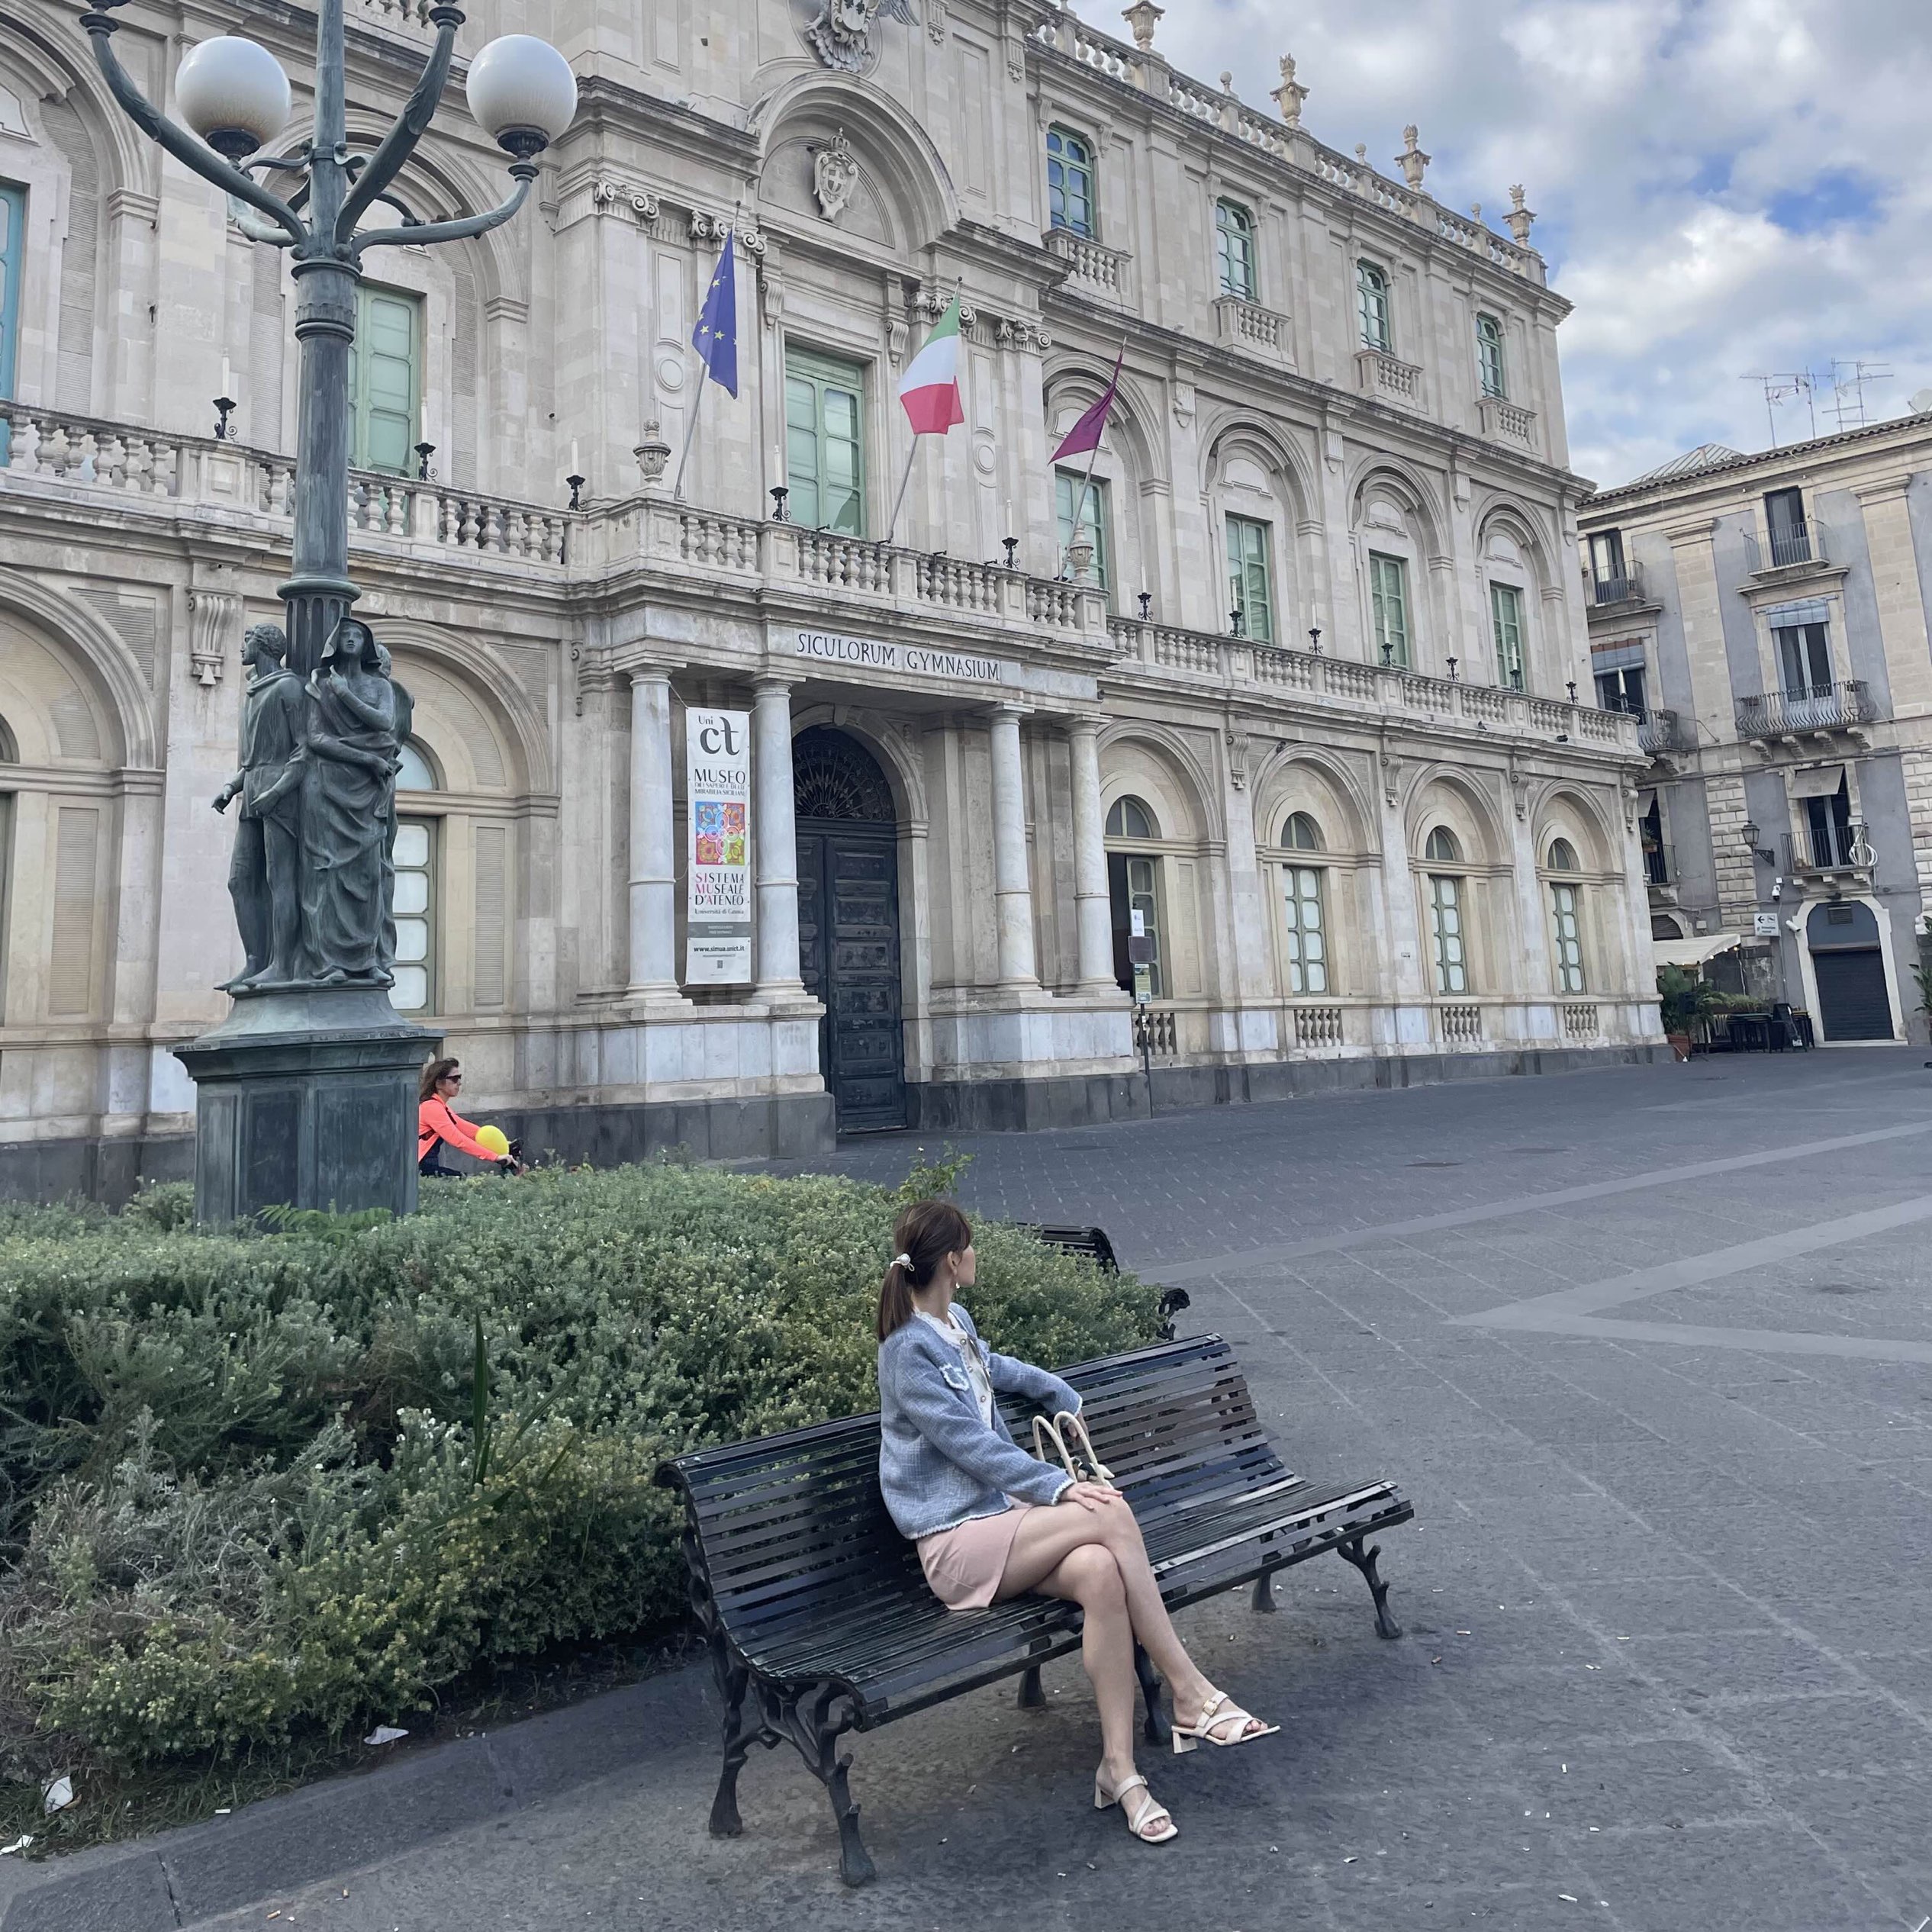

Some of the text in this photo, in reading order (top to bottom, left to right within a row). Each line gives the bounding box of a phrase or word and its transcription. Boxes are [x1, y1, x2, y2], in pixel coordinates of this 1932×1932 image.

[797, 633, 1000, 681] SICULORUM GYMNASIUM
[698, 715, 713, 725] Uni
[700, 716, 740, 755] ct
[694, 768, 745, 784] MUSEO
[695, 872, 745, 884] SISTEMA
[695, 884, 745, 894] MUSEALE
[695, 894, 744, 906] D'ATENEO
